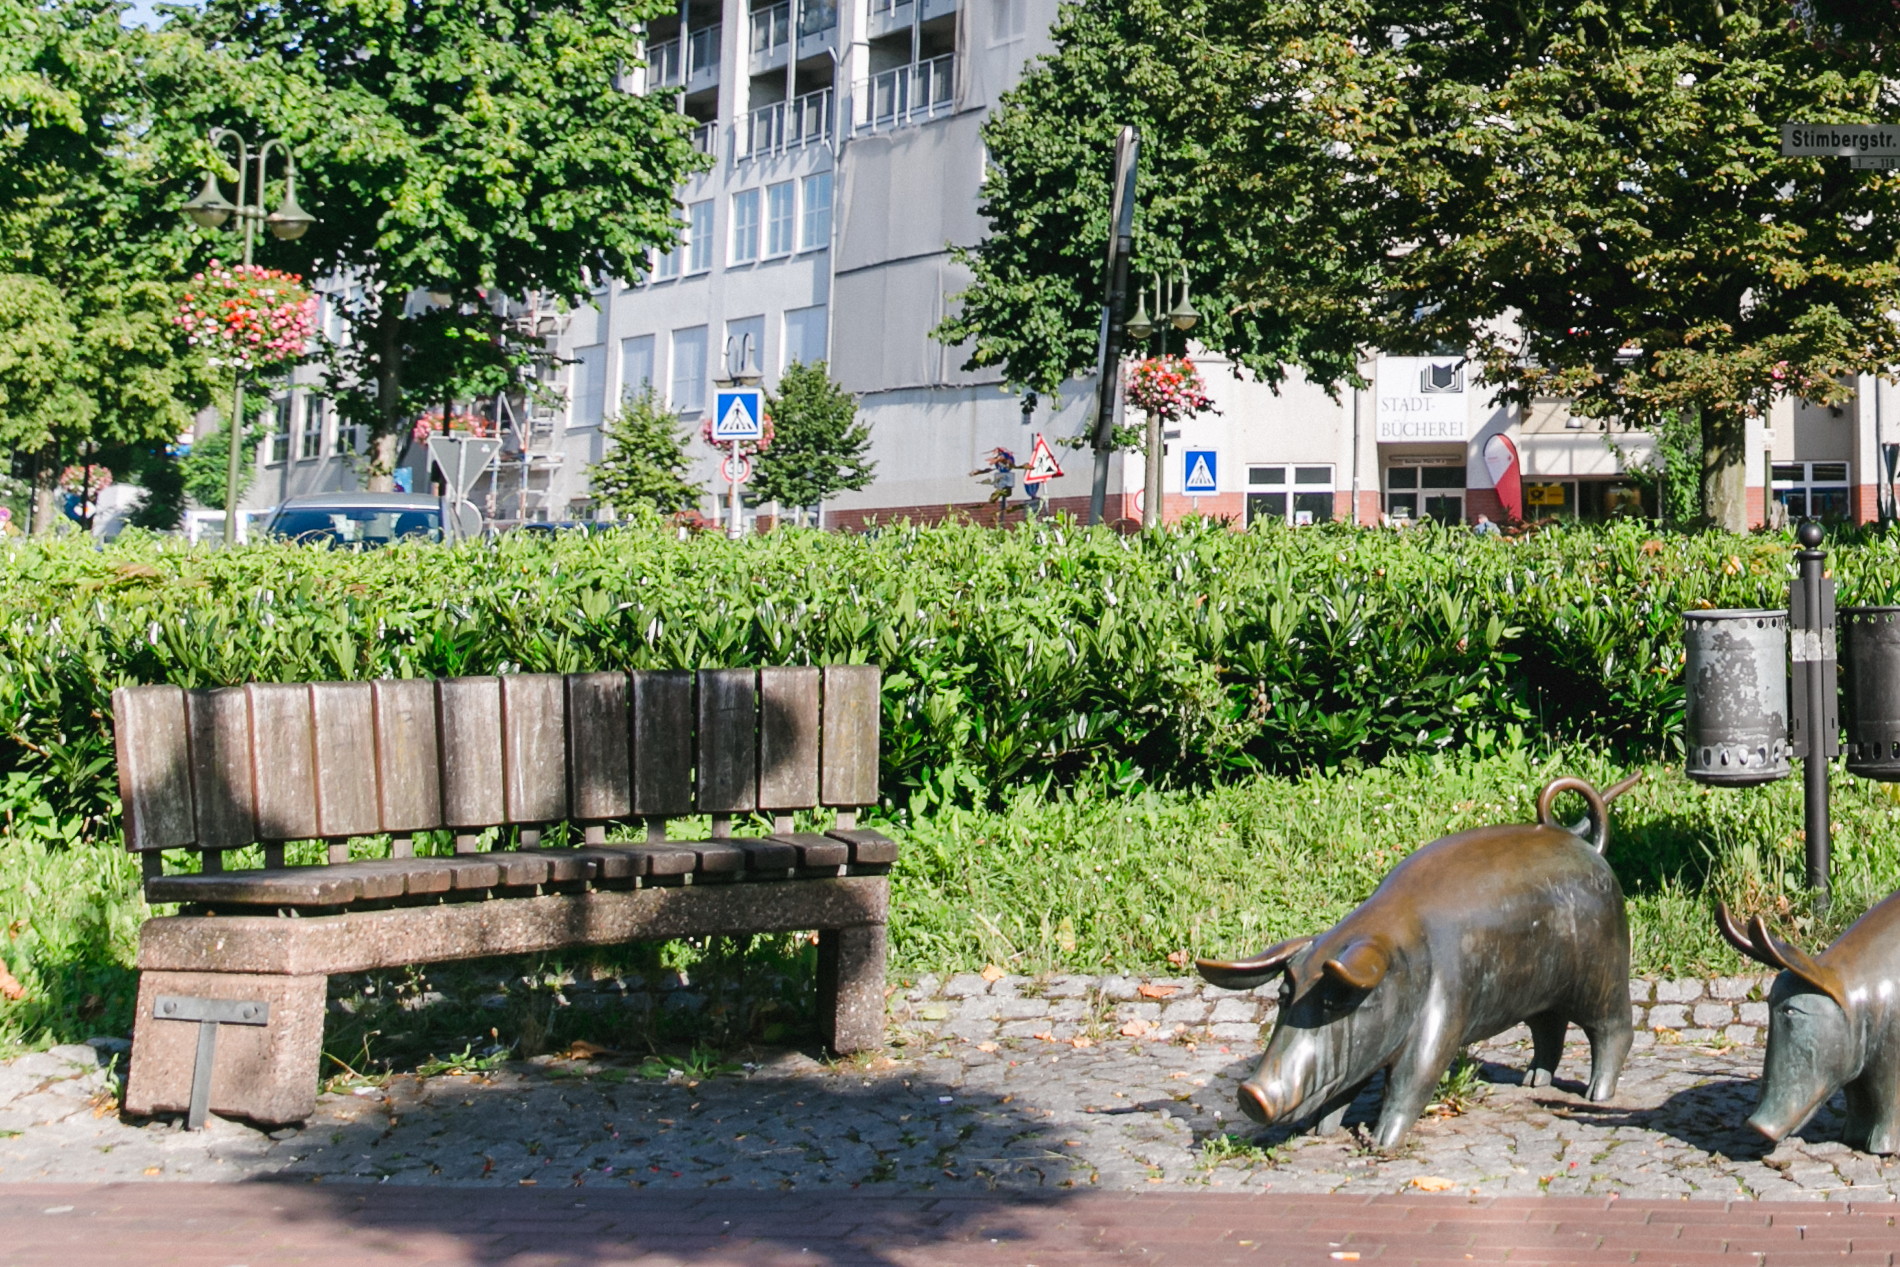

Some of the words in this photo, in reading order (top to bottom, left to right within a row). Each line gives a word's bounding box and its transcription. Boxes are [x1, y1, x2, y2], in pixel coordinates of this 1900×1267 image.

[1791, 129, 1897, 151] Stimbergstr.
[1880, 158, 1896, 168] 119
[1381, 396, 1435, 412] STADT-
[1381, 419, 1464, 437] BÜCHEREI
